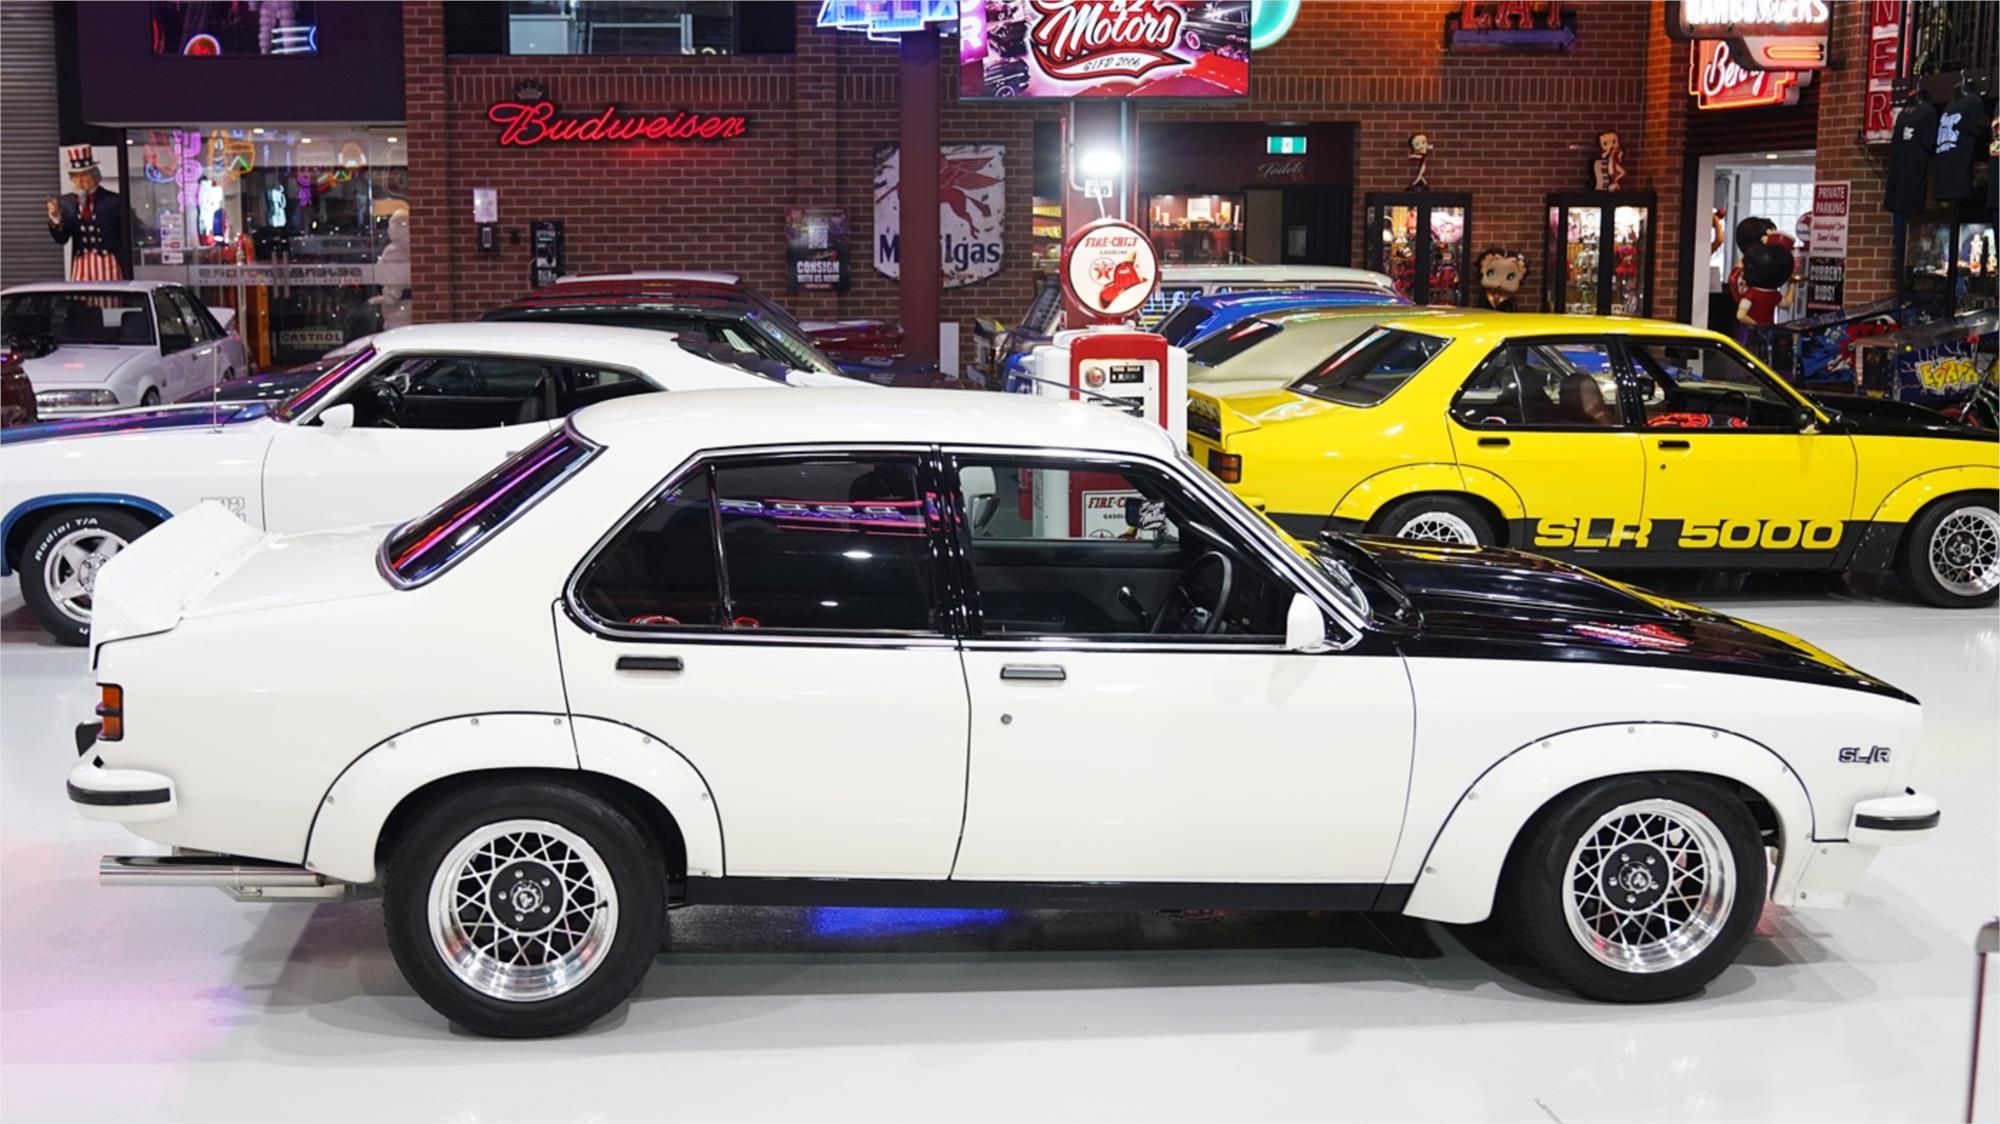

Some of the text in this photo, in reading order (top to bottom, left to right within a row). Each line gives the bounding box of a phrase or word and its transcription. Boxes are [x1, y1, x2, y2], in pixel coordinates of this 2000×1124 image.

[1038, 3, 1175, 58] Motors
[489, 102, 746, 145] Budweiser
[1818, 186, 1845, 200] PRIVATE
[1816, 201, 1845, 214] PARKING
[880, 234, 1000, 272] Mlgas
[797, 261, 840, 274] CONSIGN
[281, 332, 342, 342] CASTROL
[1088, 496, 1126, 509] FIRE-C
[35, 518, 98, 562] Radial T/A
[1534, 518, 1844, 549] SLR 5000
[1838, 745, 1891, 764] SL/R
